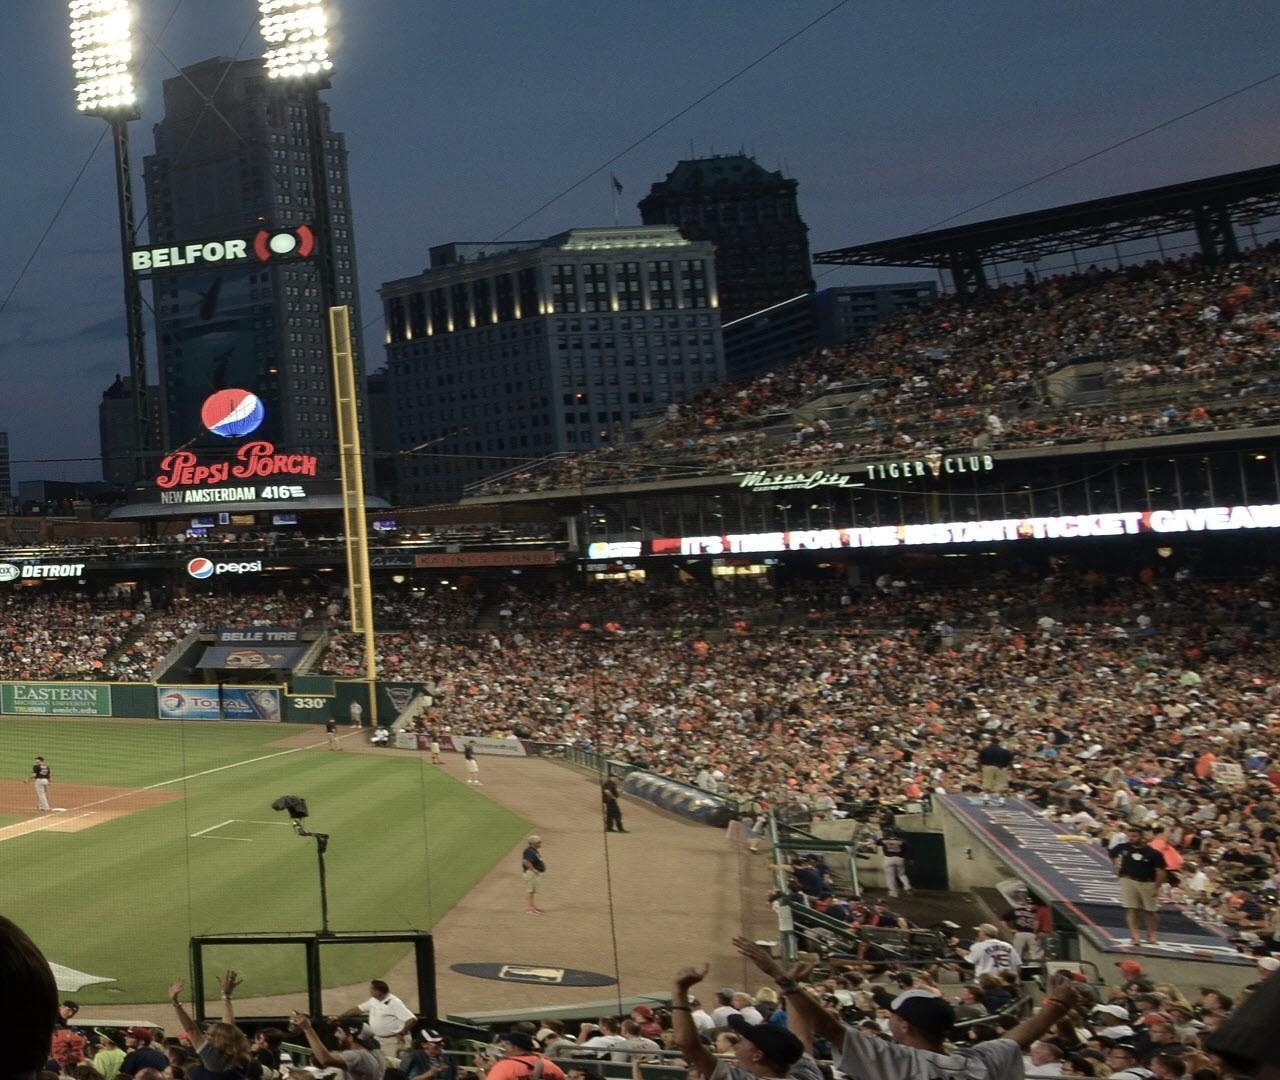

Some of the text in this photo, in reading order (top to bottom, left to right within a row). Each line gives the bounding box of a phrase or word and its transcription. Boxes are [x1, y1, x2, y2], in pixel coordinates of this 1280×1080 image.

[132, 238, 247, 271] BELFOR
[156, 441, 317, 489] PEPSI PORCH
[866, 455, 995, 480] TIGER CLUB
[161, 485, 290, 505] NEW AMSTERDAM 416
[727, 532, 788, 553] TIME
[790, 529, 839, 550] FOR
[846, 525, 899, 548] THE
[903, 519, 1020, 545] INSTANT
[1030, 512, 1142, 539] TICKET
[22, 563, 85, 578] DETROIT
[215, 561, 263, 575] pepsi
[221, 631, 297, 641] BELLE TIRE
[13, 685, 97, 700] EASTERN
[191, 696, 250, 709] TOTAL
